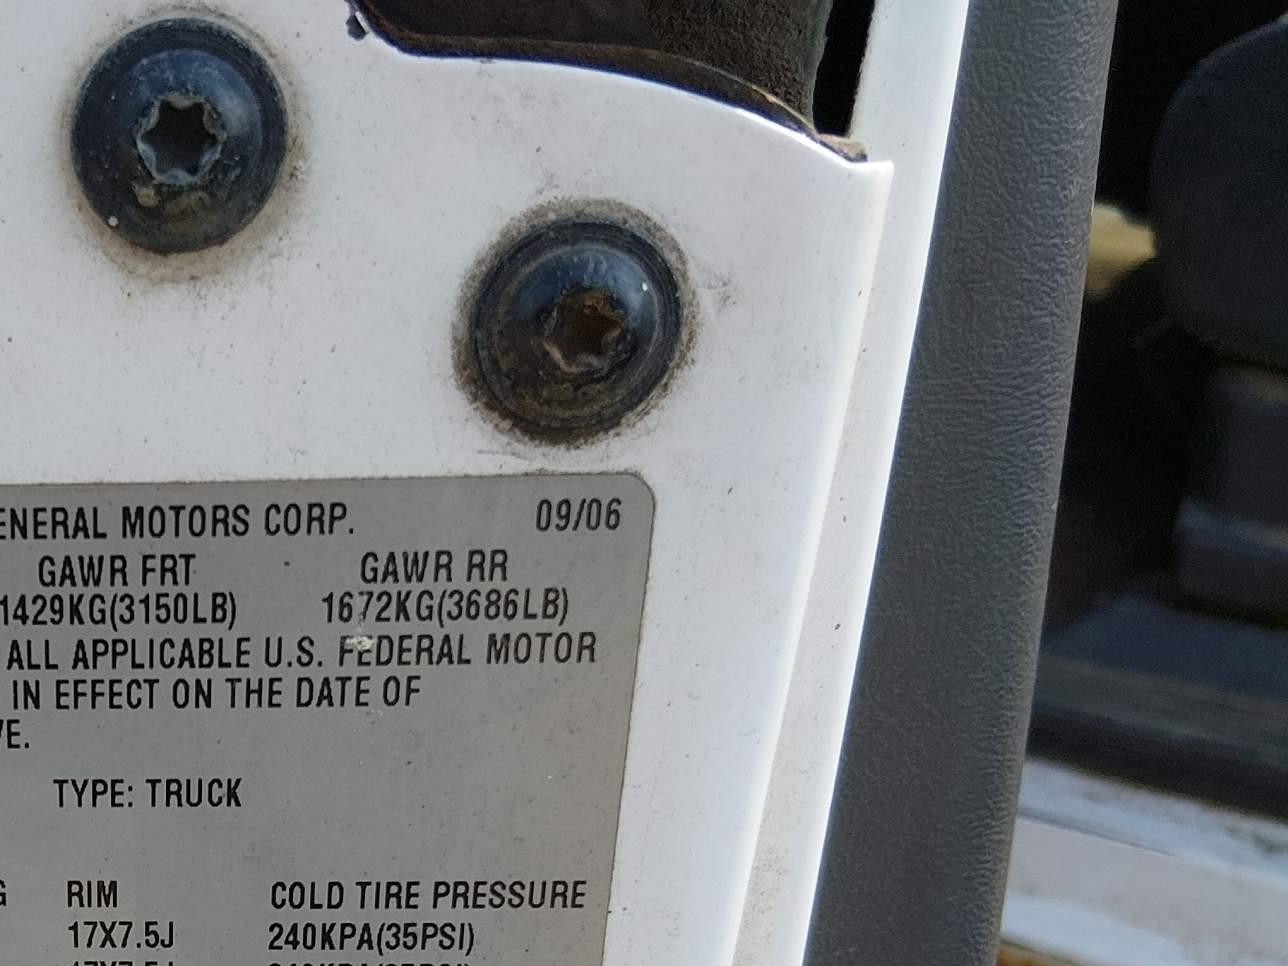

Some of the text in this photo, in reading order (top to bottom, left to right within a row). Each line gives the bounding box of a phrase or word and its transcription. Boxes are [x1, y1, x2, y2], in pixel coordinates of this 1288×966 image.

[122, 504, 249, 538] MOTORS
[265, 502, 353, 536] CORP.
[536, 498, 621, 531] 09/06
[39, 554, 196, 587] GAWR FRT
[361, 550, 507, 584] GAWR RR
[322, 588, 568, 628] 1672KG(3686LB)
[7, 640, 58, 670] ALL
[72, 637, 250, 670] APPLICABLE
[265, 636, 322, 667] U.S.
[339, 634, 471, 666] FEDERAL
[487, 632, 596, 664] MOTOR
[13, 680, 40, 709] IN
[56, 679, 159, 709] EFFECT
[173, 679, 211, 708] ON
[225, 678, 282, 708] THE
[296, 676, 370, 707] DATE
[383, 676, 420, 706] OF
[53, 778, 241, 807] TYPE: TRUCK
[68, 881, 117, 907] RIM
[272, 881, 586, 909] COLD TIRE PRESSURE
[69, 921, 173, 948] 17X7.5J
[269, 923, 474, 956] 240KPA(35PSI)
